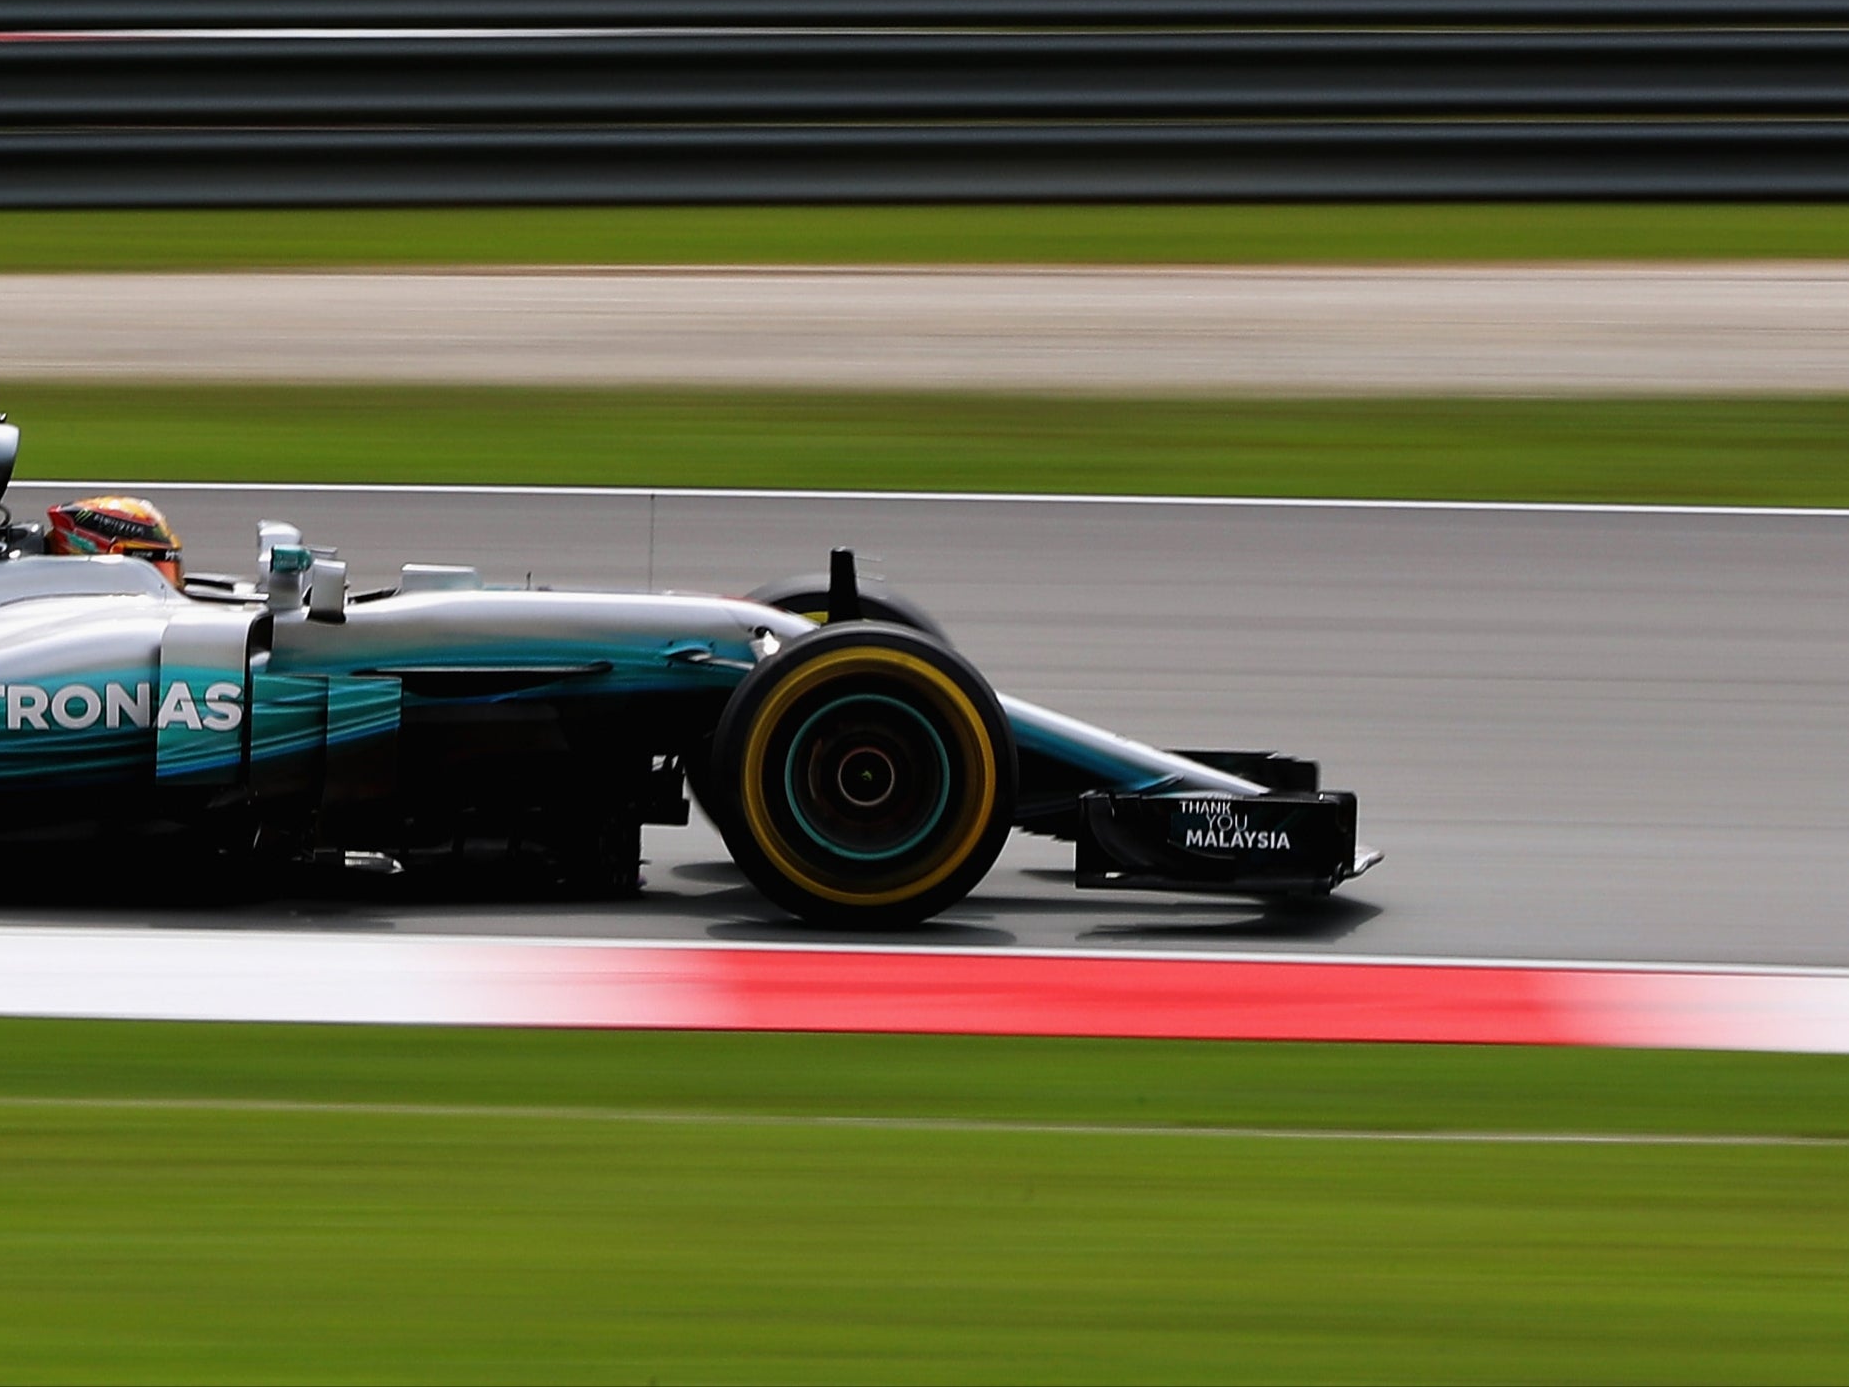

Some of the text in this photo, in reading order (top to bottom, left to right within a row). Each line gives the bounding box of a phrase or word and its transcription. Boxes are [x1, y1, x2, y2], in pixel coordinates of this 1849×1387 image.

[1179, 800, 1231, 815] THANK
[1206, 813, 1248, 832] YOU
[1185, 829, 1291, 850] MALAYSIA
